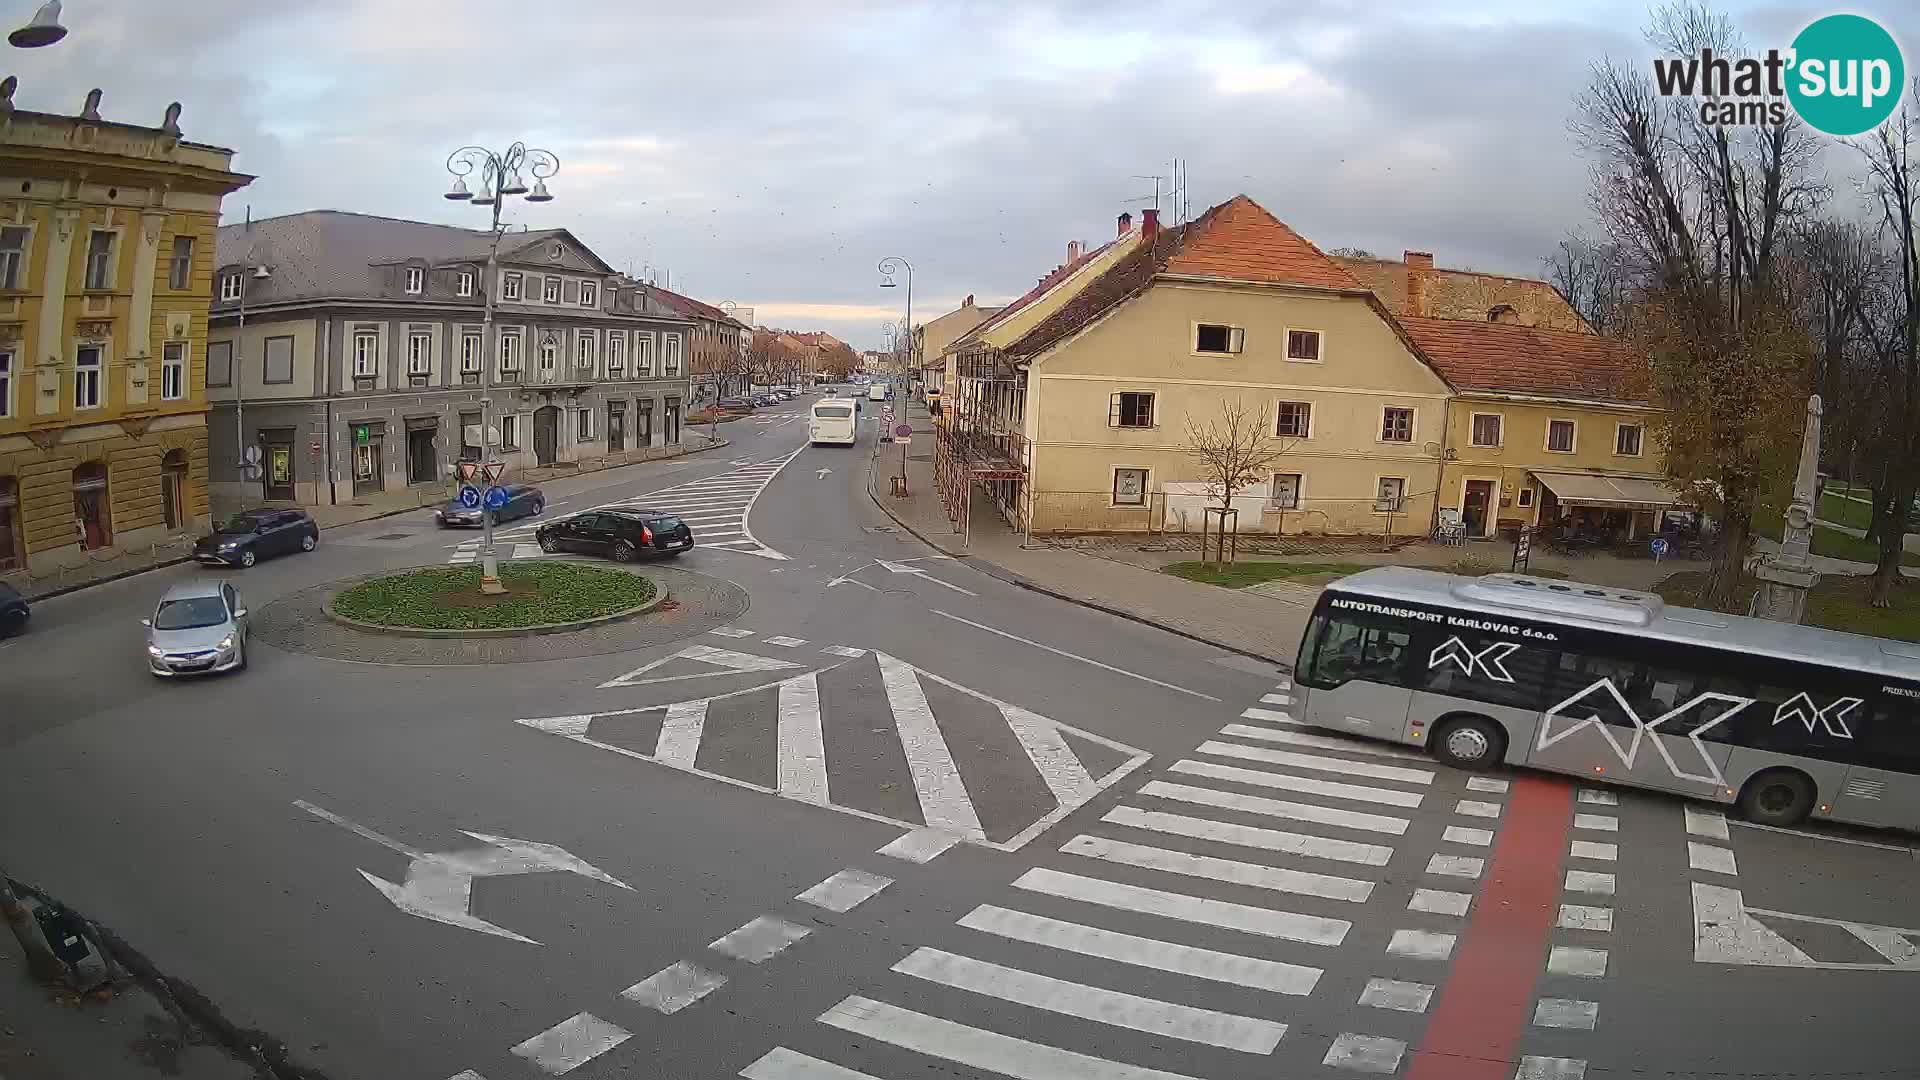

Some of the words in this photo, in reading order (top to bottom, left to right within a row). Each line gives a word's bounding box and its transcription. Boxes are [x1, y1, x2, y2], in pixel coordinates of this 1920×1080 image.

[1330, 598, 1444, 625] AUTOTRANSPORT
[1447, 615, 1520, 635] KARLOVAC
[1521, 626, 1559, 641] d.o.o.
